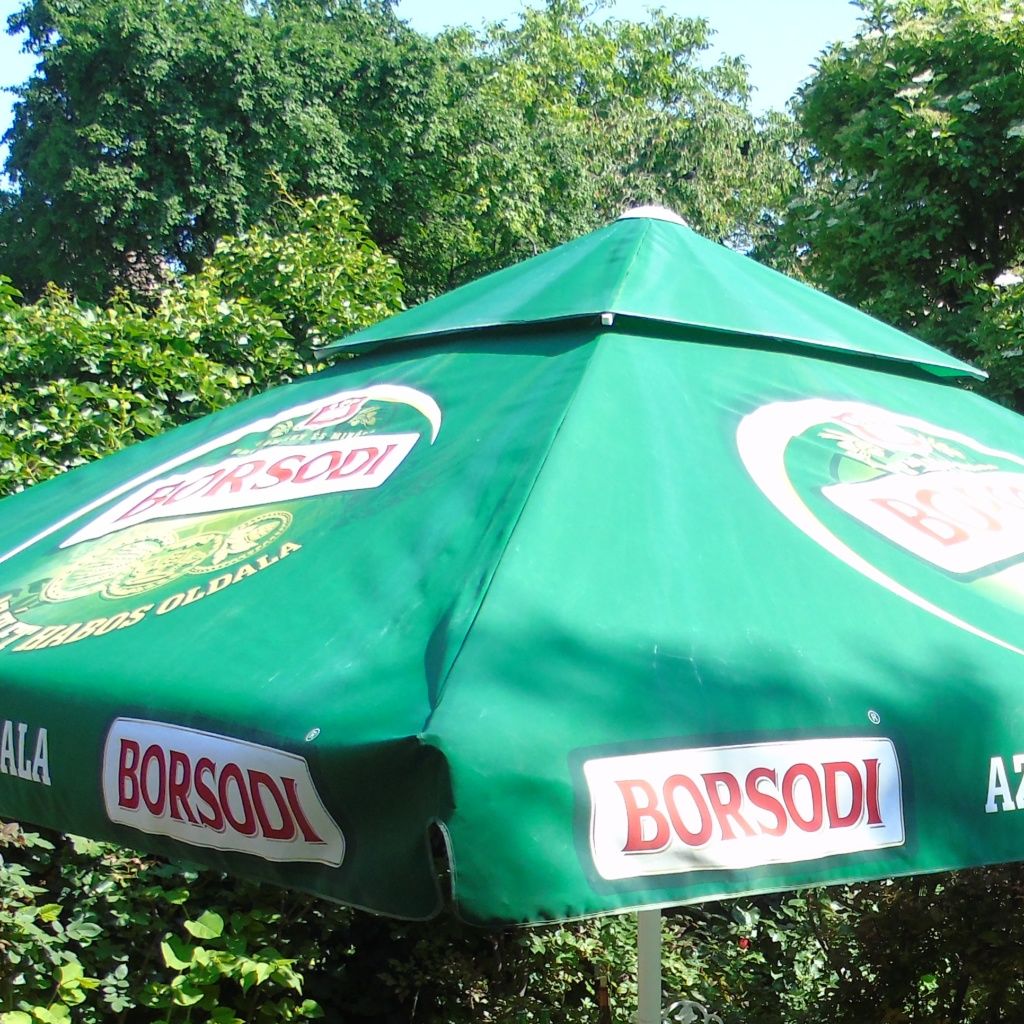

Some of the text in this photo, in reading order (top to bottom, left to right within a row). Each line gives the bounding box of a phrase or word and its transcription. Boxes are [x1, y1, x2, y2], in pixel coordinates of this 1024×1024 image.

[114, 443, 398, 523] BORSODI
[12, 602, 156, 652] HABOS
[156, 541, 303, 615] OLDALA
[118, 739, 328, 845] BORSODI
[615, 759, 885, 855] BORSODI
